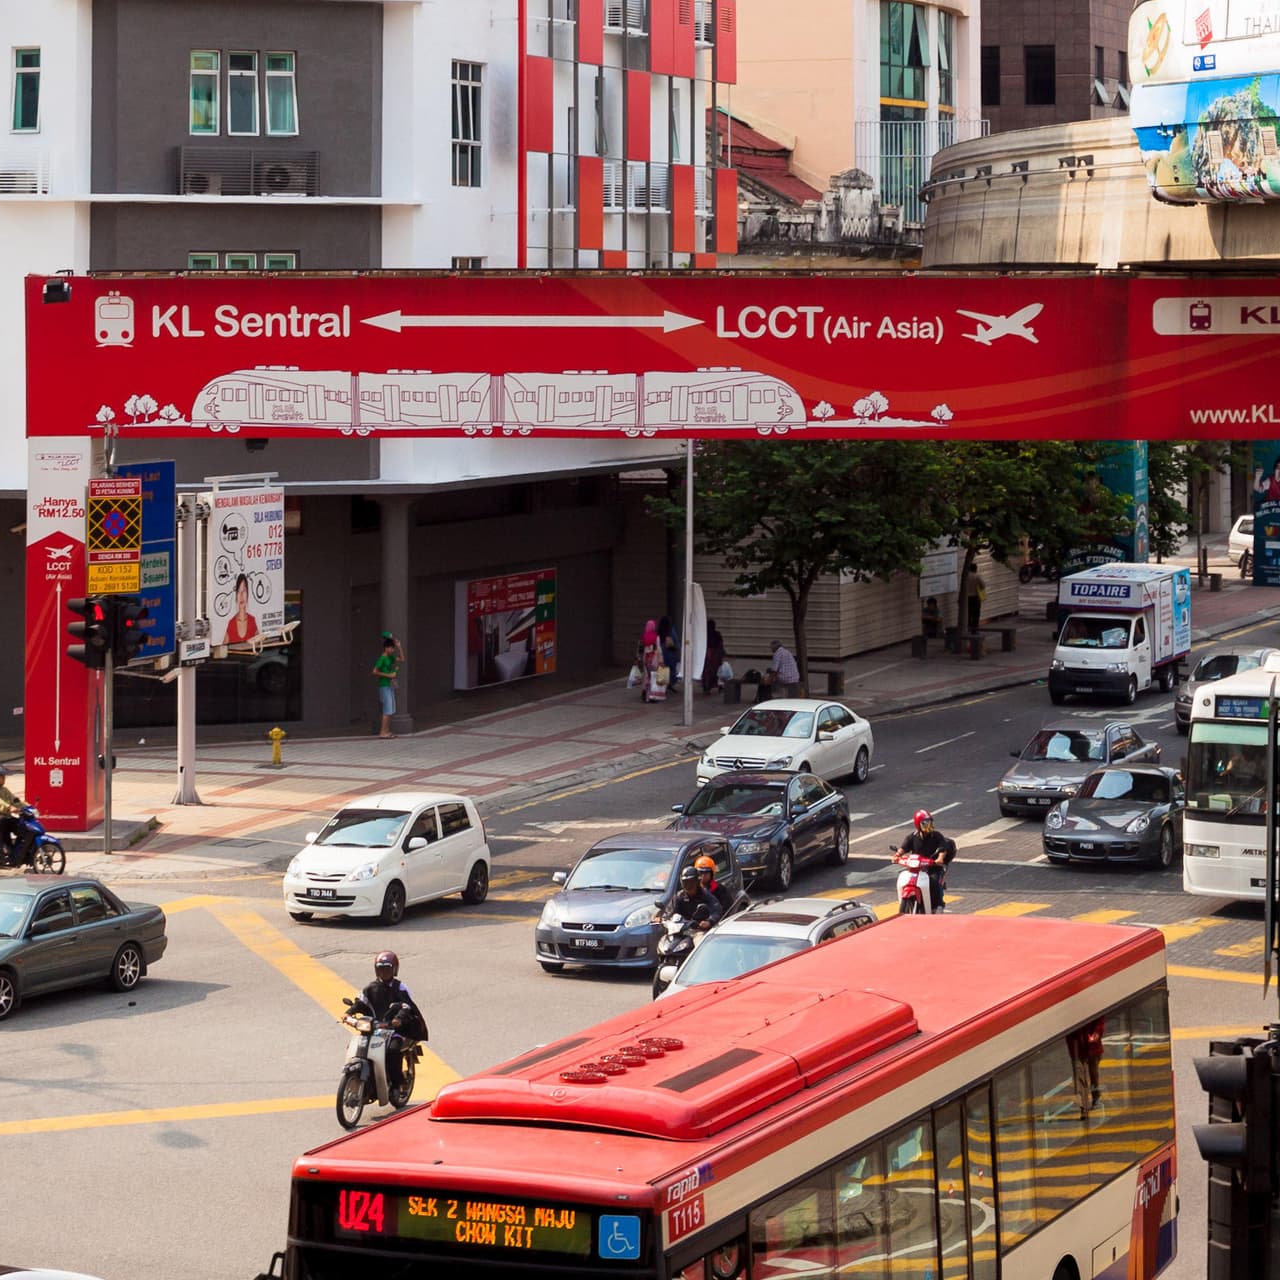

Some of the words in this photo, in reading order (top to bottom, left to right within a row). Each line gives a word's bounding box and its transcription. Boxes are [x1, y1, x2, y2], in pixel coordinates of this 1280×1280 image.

[152, 305, 204, 338] KL
[215, 305, 350, 339] Sentral
[717, 305, 823, 340] LCCT
[824, 317, 872, 345] (Air
[877, 316, 944, 345] Asia)
[43, 497, 77, 510] Hanya
[38, 508, 85, 518] RM12.50
[269, 524, 283, 538] 012
[247, 543, 262, 559] 616
[264, 541, 283, 557] 7778
[46, 562, 72, 571] LCCT
[1073, 584, 1128, 597] TOPAIRE
[34, 757, 47, 766] KL
[48, 756, 80, 766] Sentral
[338, 1189, 385, 1234] U24
[408, 1195, 438, 1219] SEK
[448, 1199, 458, 1220] 2
[466, 1202, 526, 1225] WANGSA
[534, 1208, 576, 1231] MAJU
[672, 1199, 702, 1236] T115
[455, 1220, 497, 1245] CHOW
[504, 1226, 534, 1249] KIT
